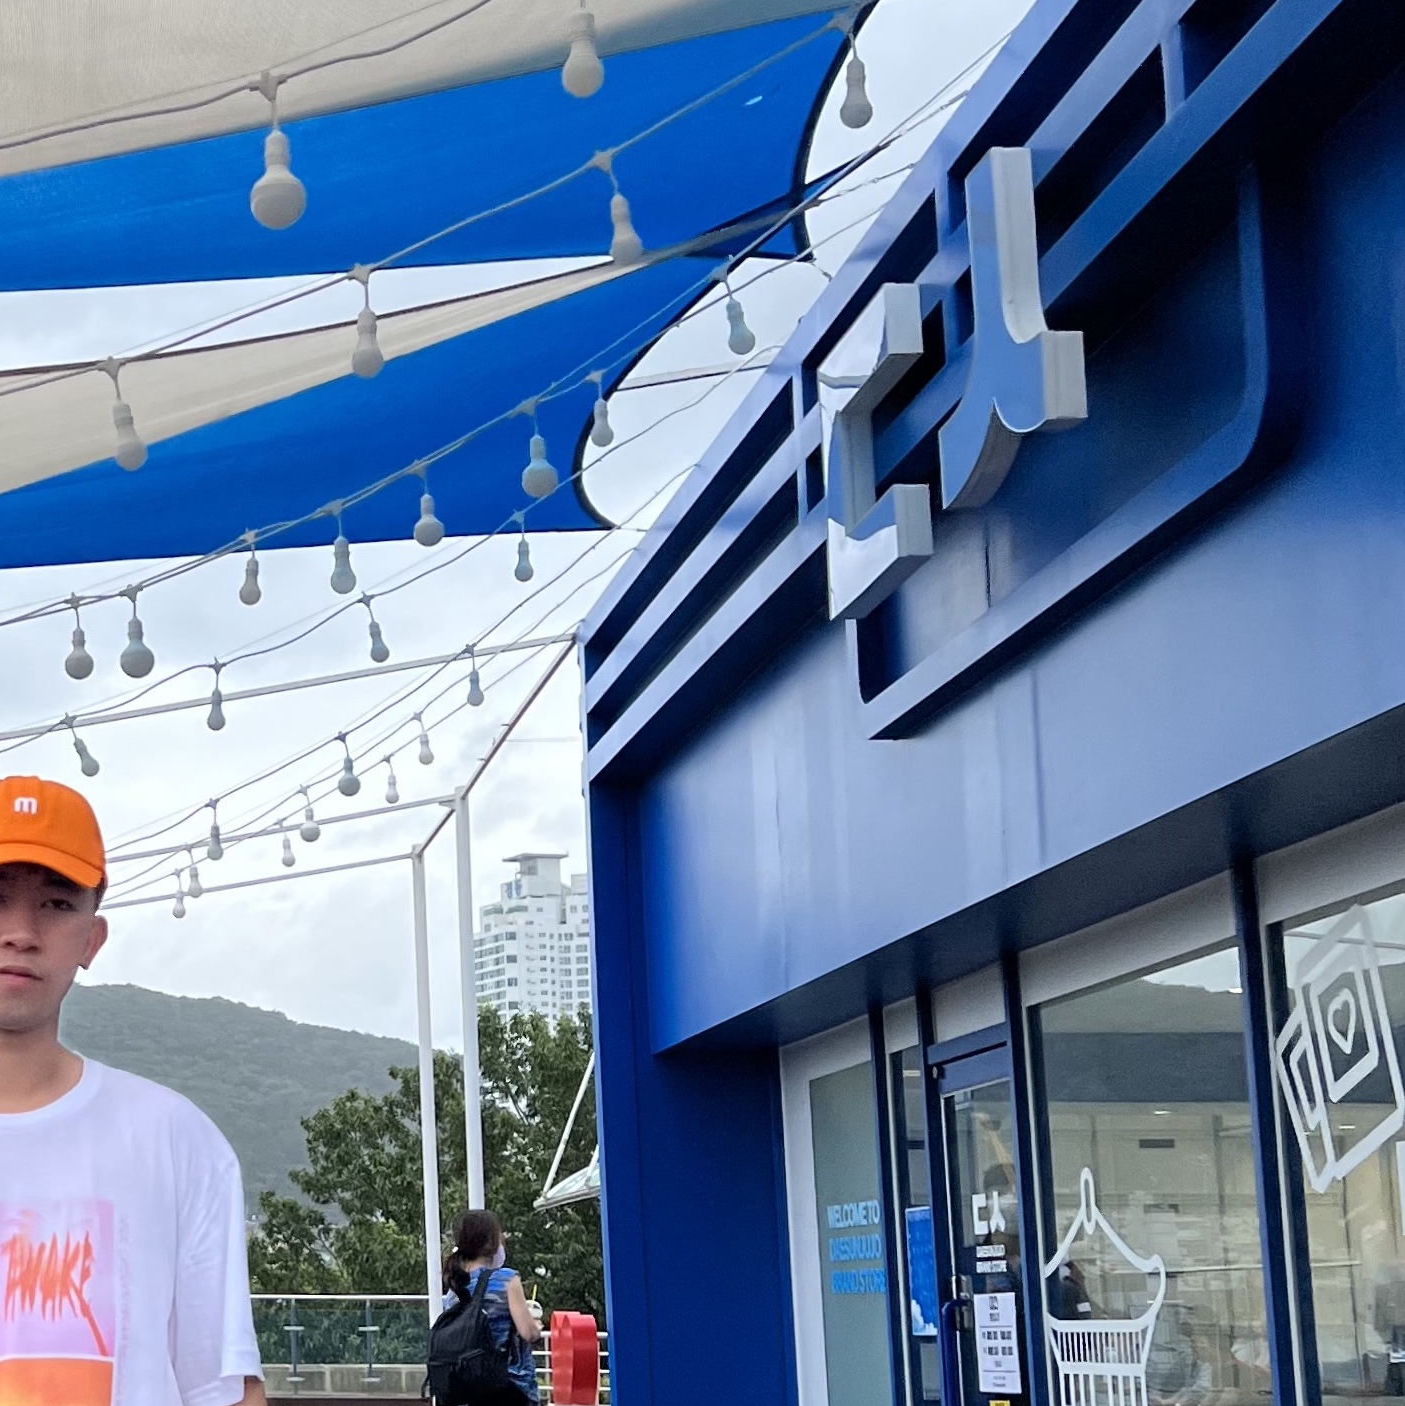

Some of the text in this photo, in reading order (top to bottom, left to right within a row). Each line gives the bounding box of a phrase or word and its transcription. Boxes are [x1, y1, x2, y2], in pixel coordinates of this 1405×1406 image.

[14, 797, 38, 815] m
[827, 1199, 881, 1229] WELCOME TO
[3, 1230, 95, 1323] AWAKE
